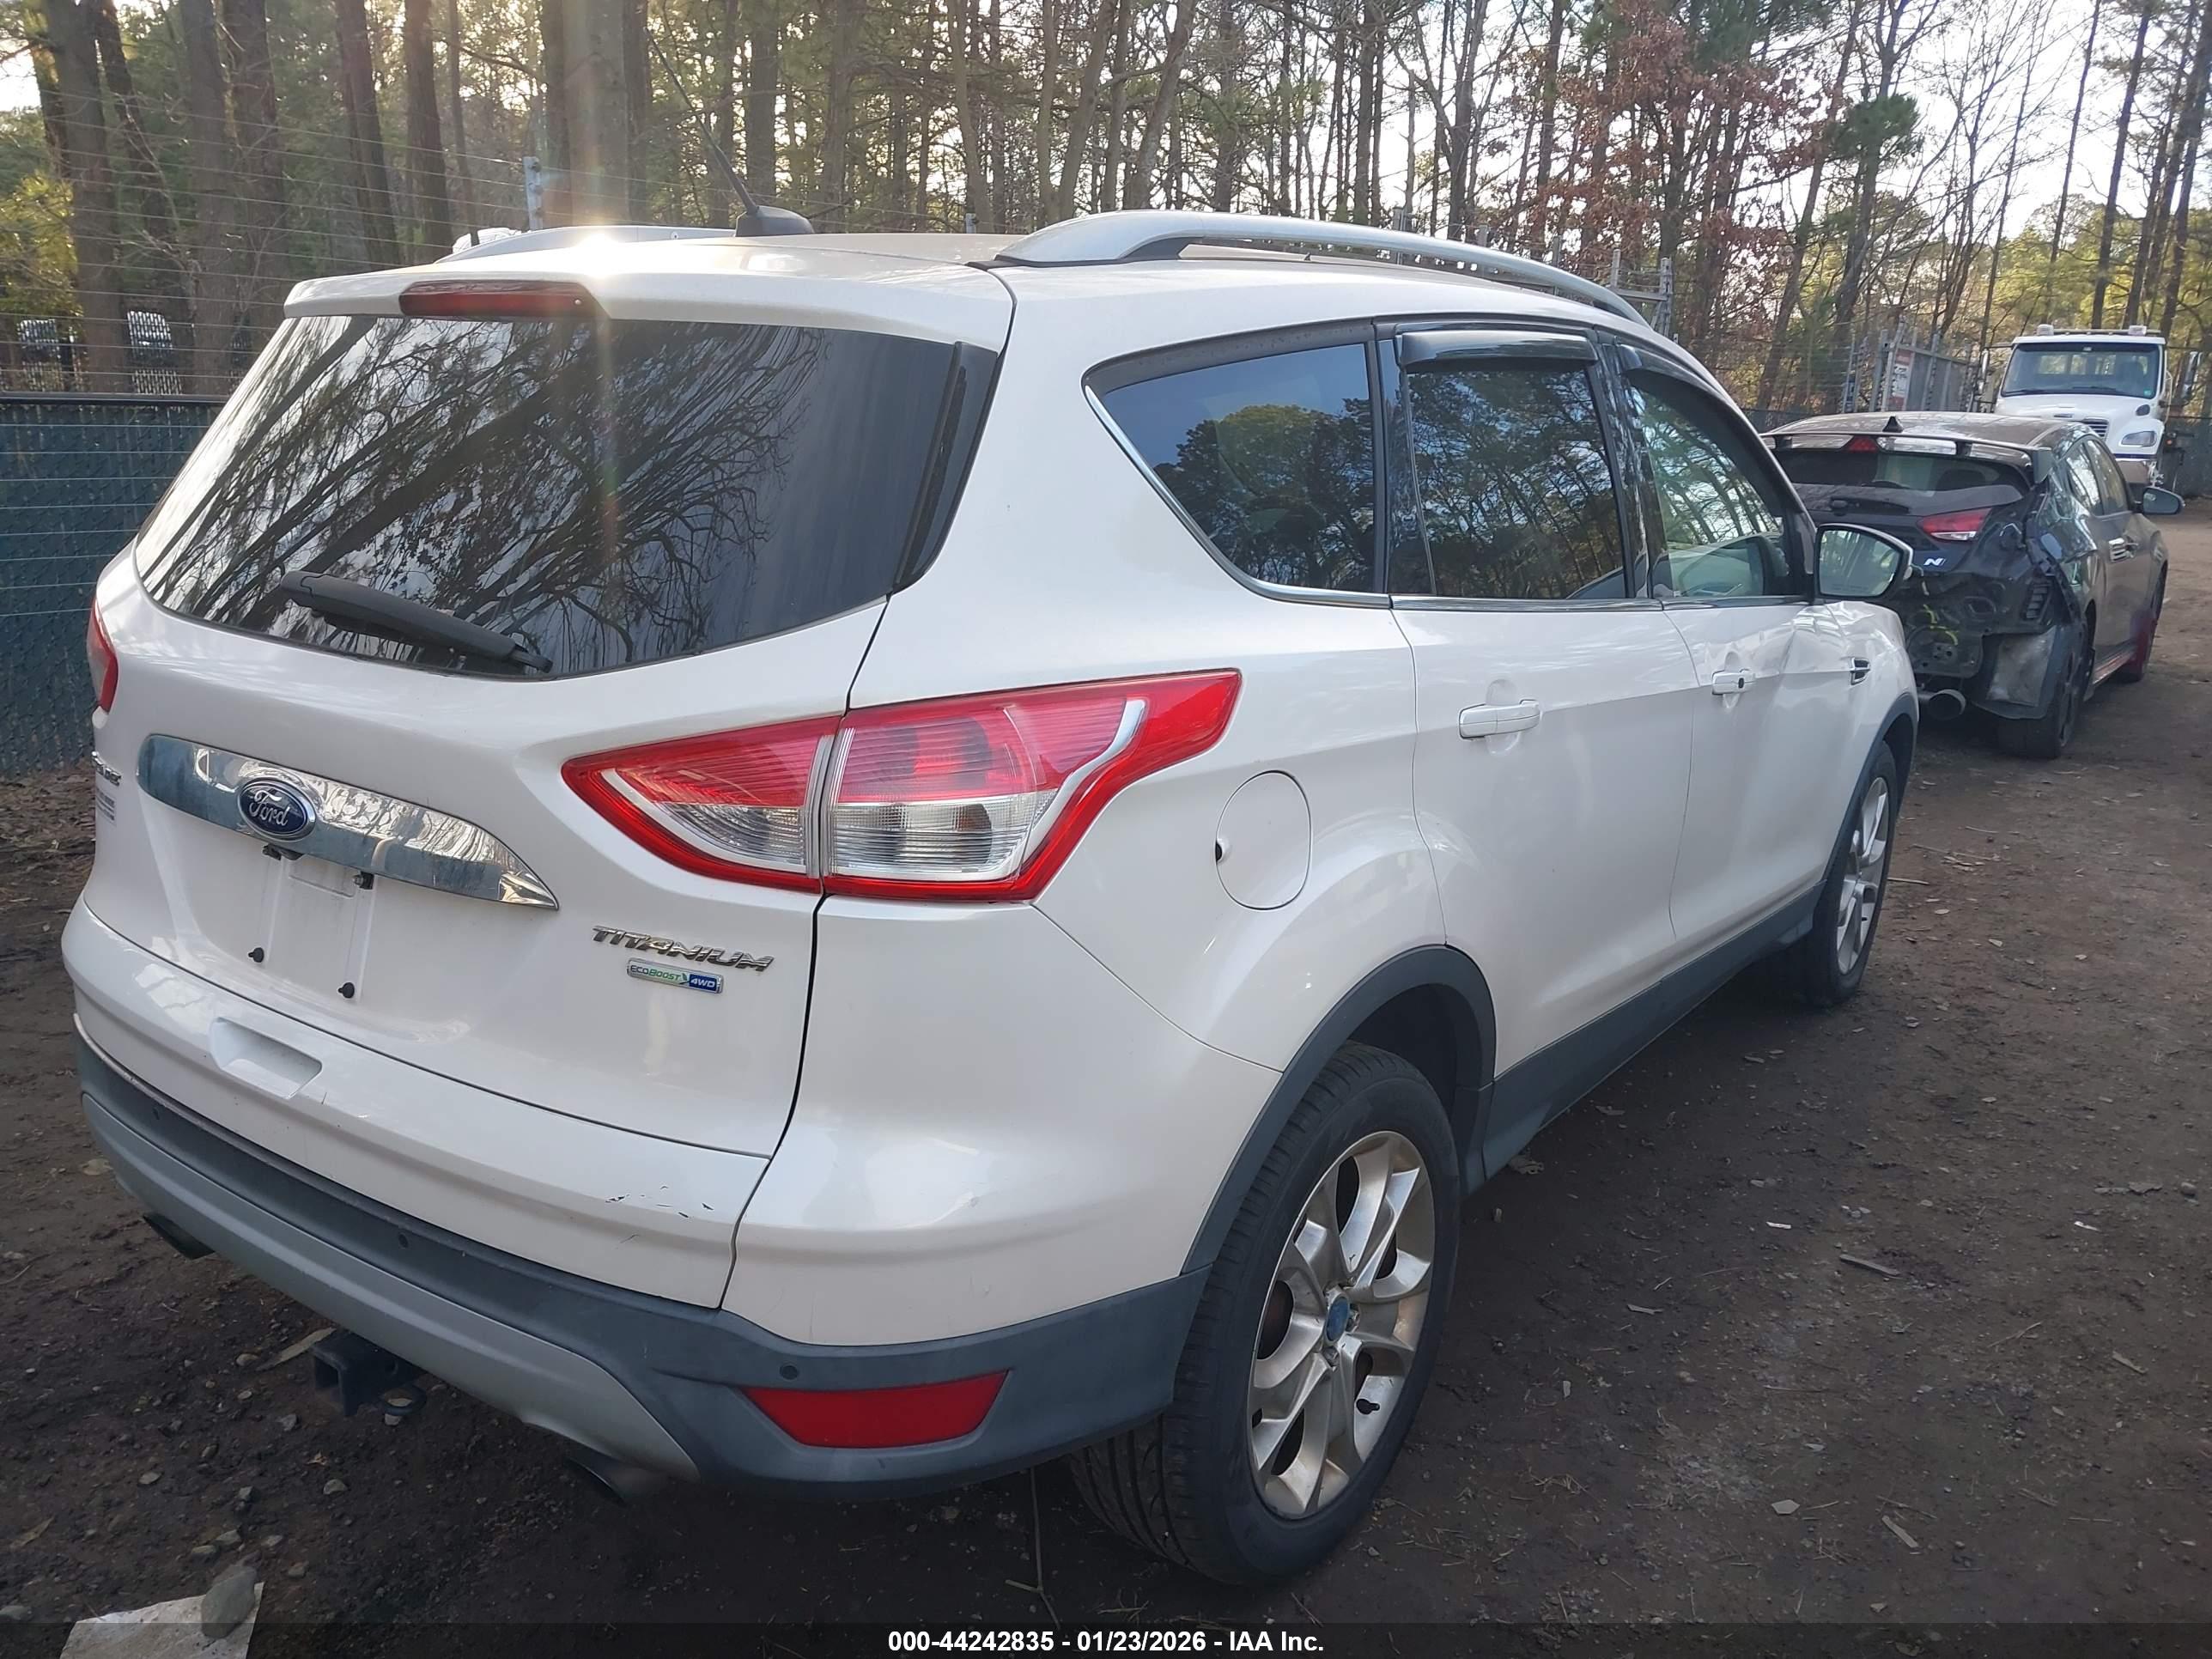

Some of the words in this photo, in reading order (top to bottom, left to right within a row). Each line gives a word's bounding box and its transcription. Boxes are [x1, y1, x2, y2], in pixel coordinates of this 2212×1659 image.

[249, 789, 291, 826] Ford
[592, 925, 775, 972] TITANIUM
[630, 964, 682, 981] ECOBOOST
[690, 977, 715, 989] 4WD
